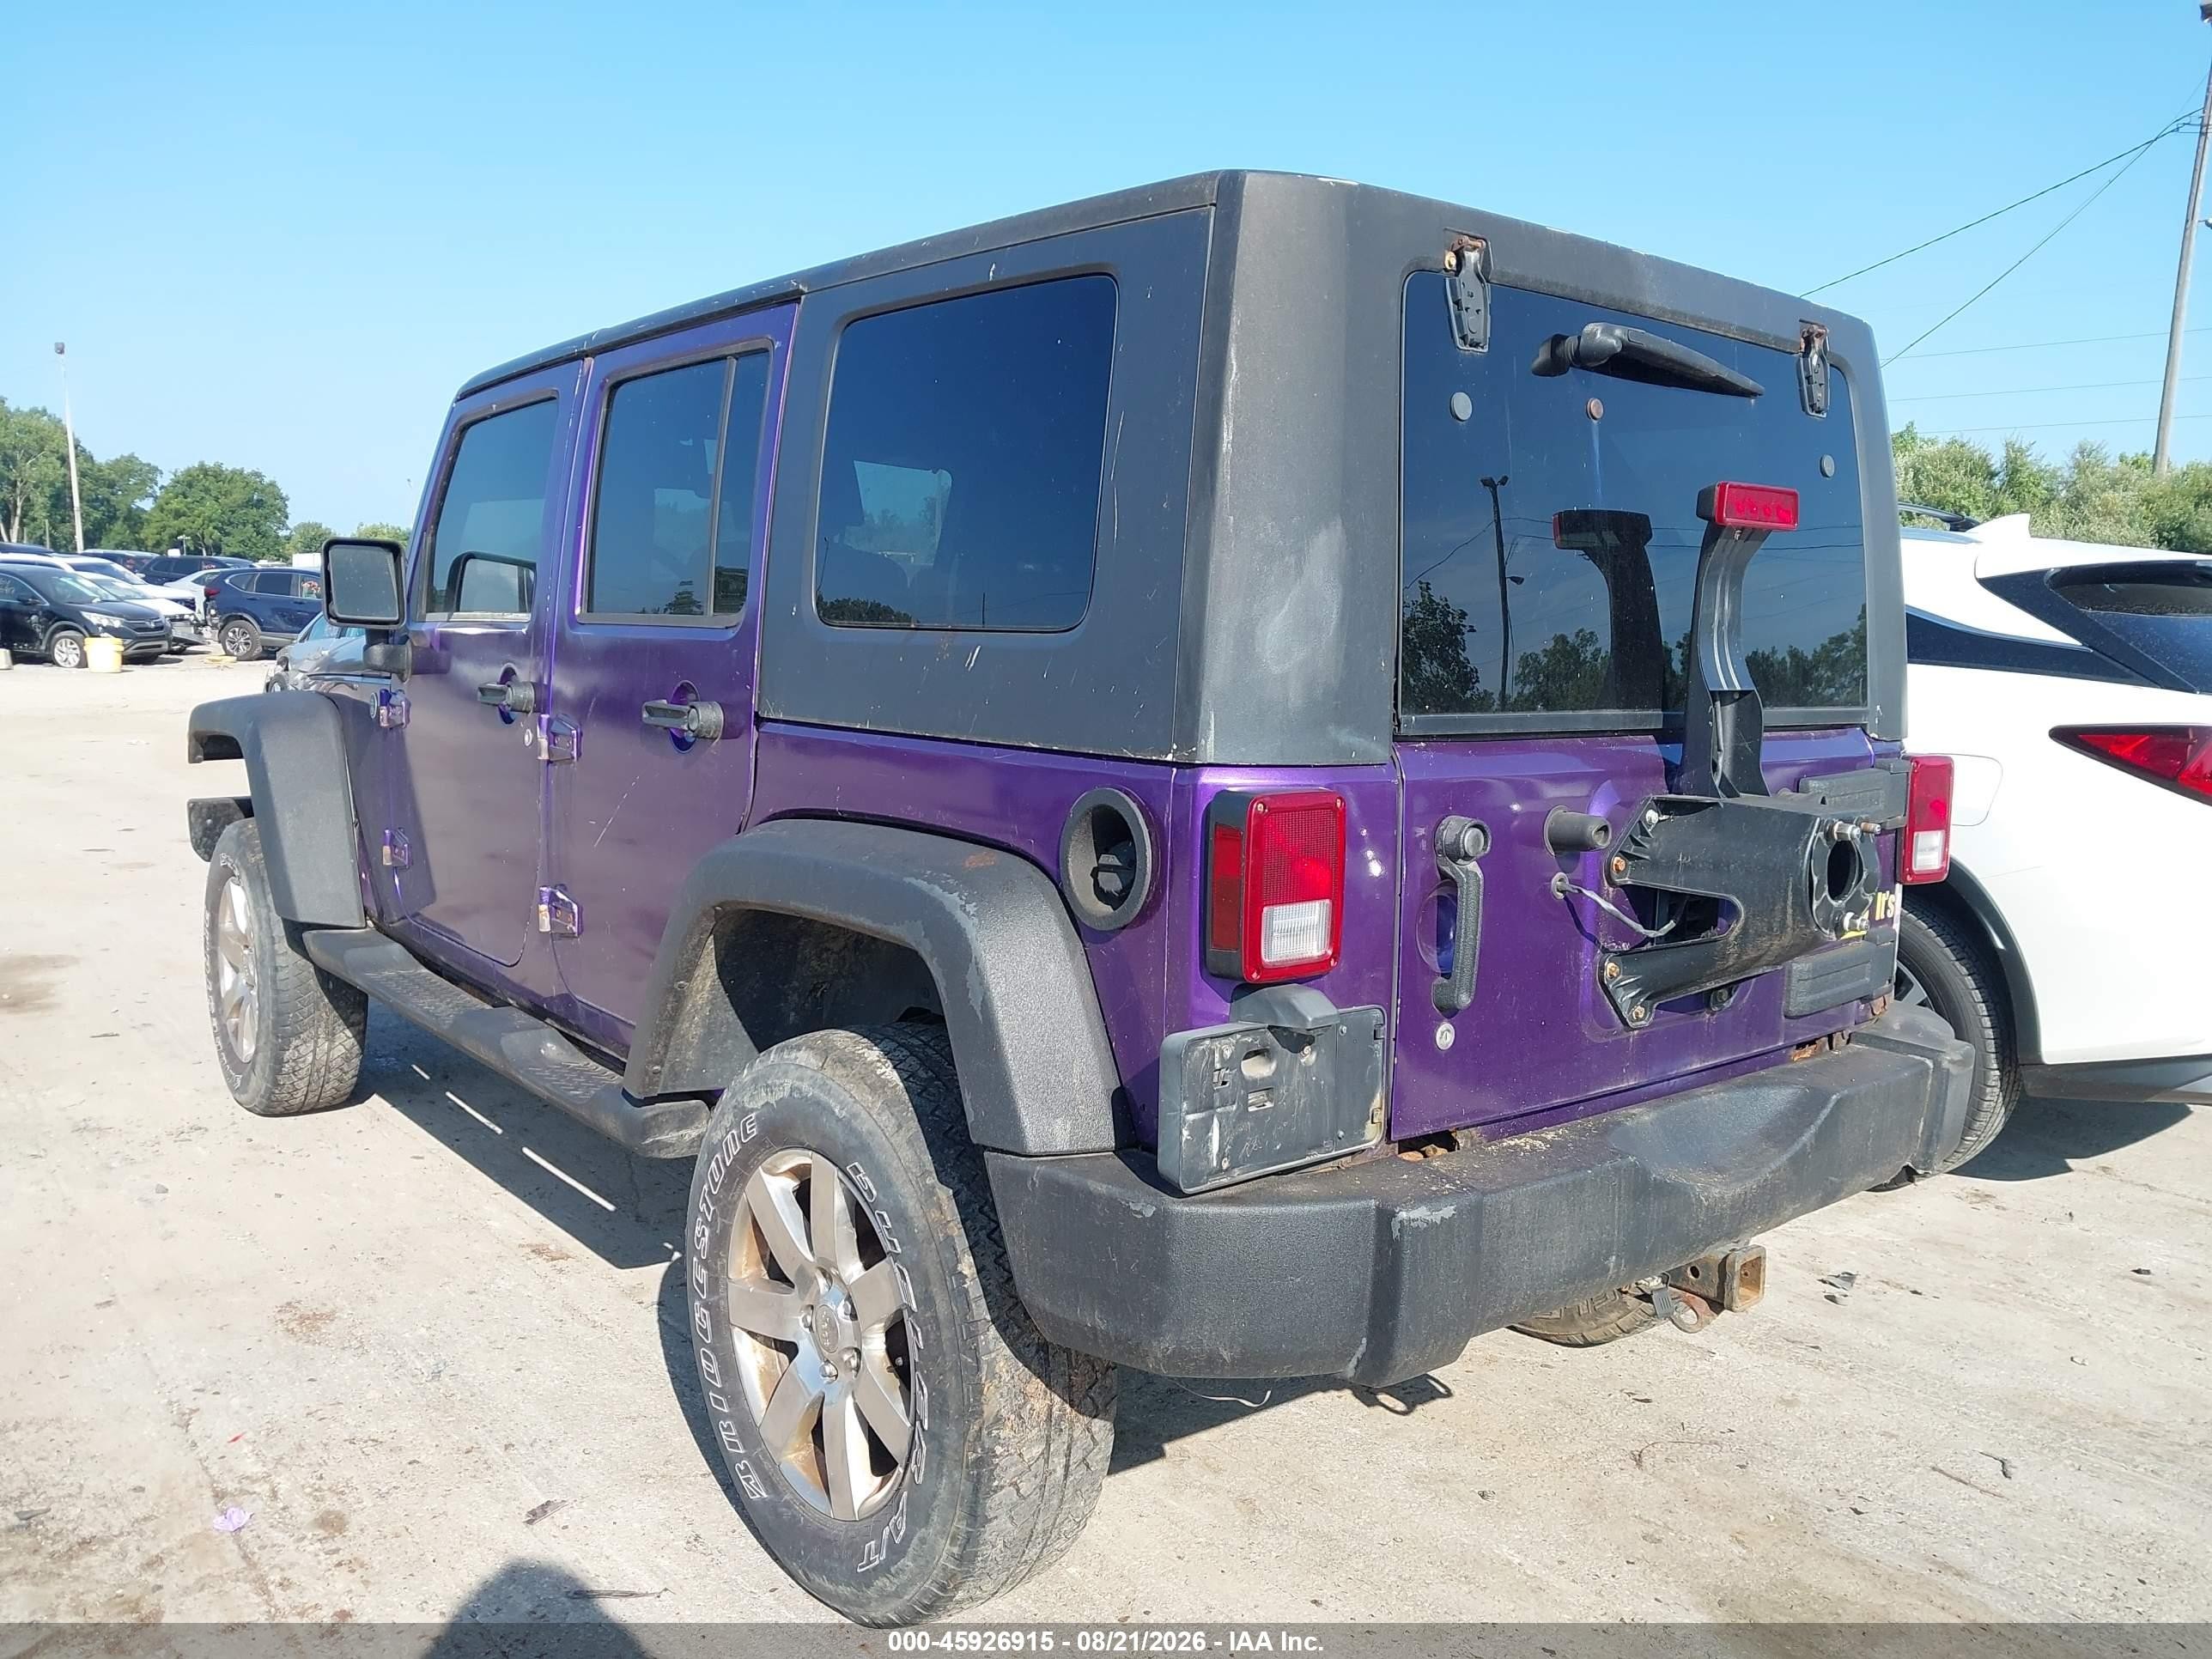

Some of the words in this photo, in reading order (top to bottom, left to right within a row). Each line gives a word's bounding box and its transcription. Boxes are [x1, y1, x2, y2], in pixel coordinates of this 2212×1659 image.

[692, 1112, 769, 1500] BRIDGESTONE
[846, 1161, 928, 1485] DUELER
[856, 1490, 908, 1573] A/T
